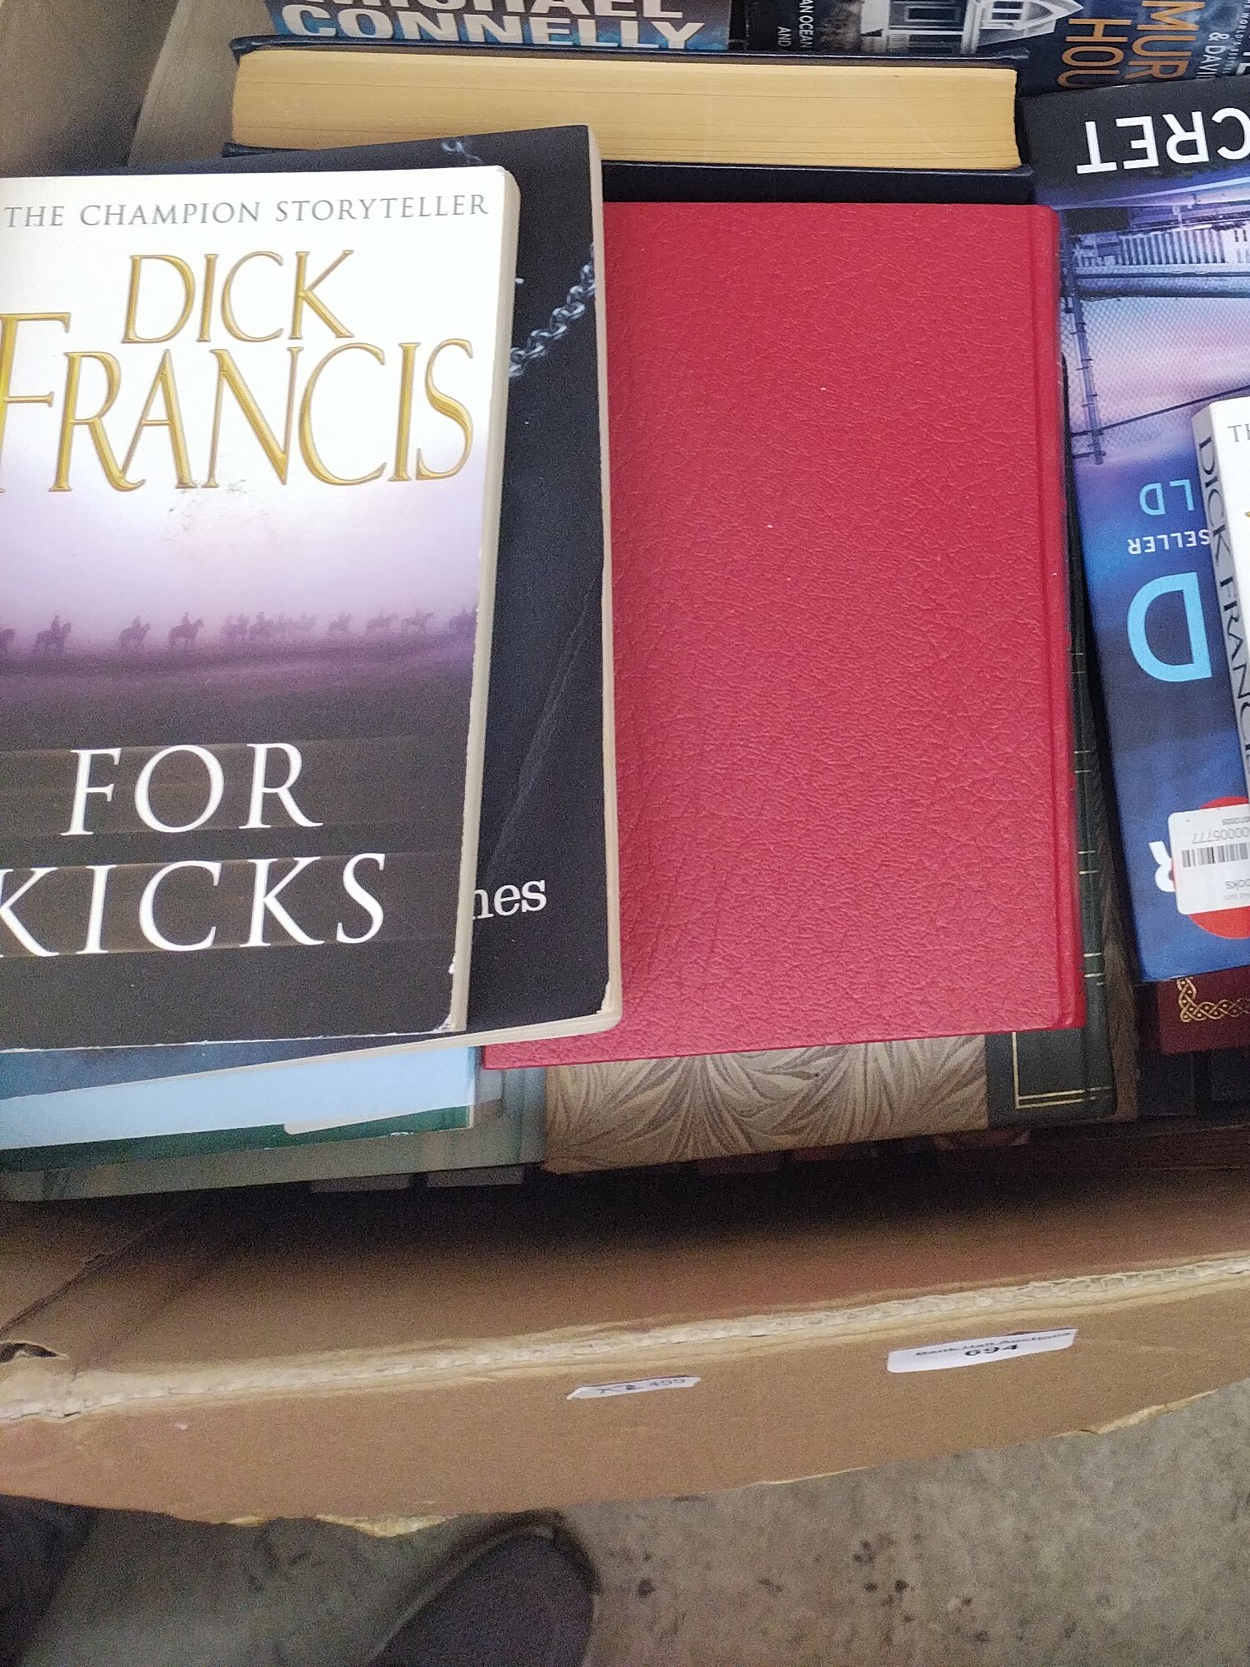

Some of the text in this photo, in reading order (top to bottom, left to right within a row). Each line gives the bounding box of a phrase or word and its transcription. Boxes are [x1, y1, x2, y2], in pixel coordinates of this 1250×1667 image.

[280, 3, 707, 50] CONNELLY
[776, 25, 792, 48] AND
[799, 14, 814, 50] OCEAN
[1195, 31, 1230, 79] & DAVI
[3, 193, 490, 228] THE CHAMPION STORYTELLER
[121, 249, 356, 345] DICK
[0, 311, 475, 494] FRANCIS
[1199, 435, 1233, 567] DICK
[60, 742, 325, 837] FOR
[0, 852, 387, 959] KICKS
